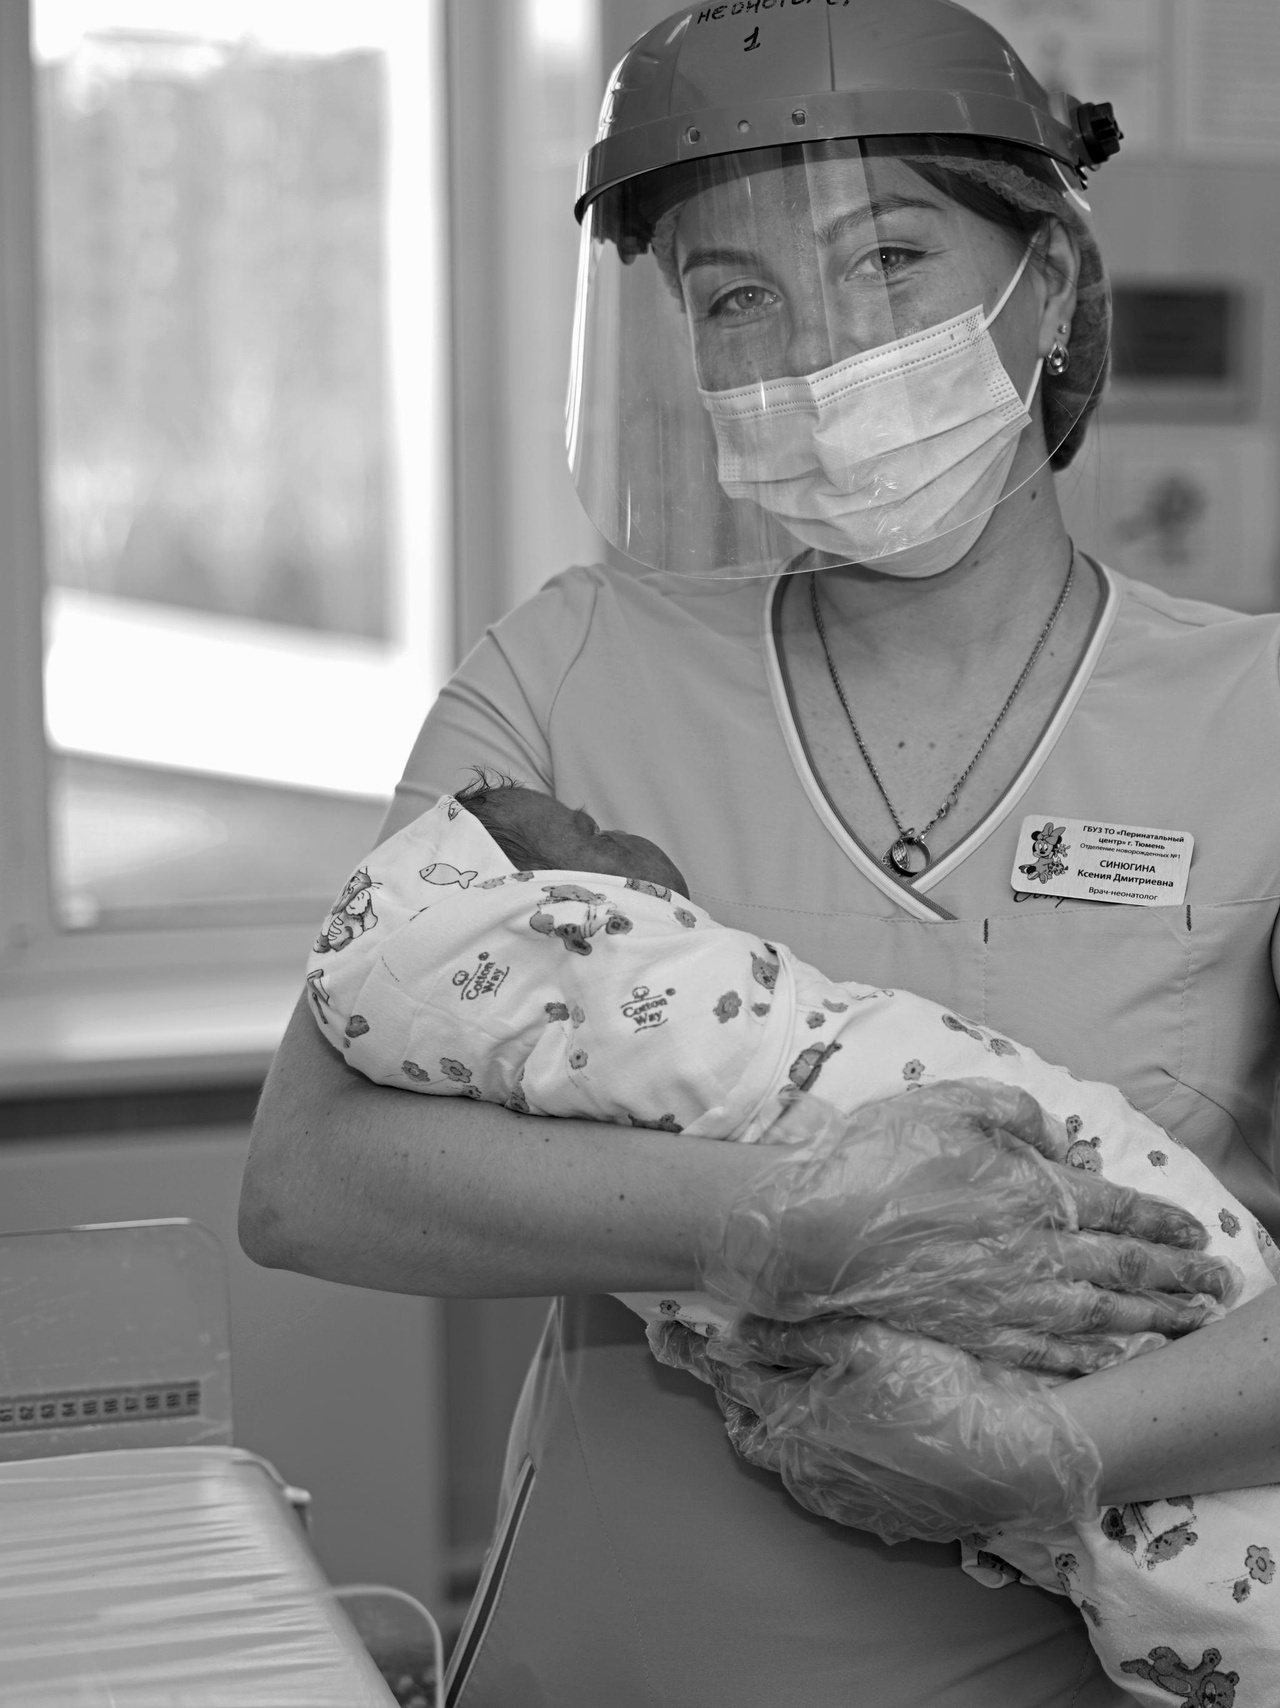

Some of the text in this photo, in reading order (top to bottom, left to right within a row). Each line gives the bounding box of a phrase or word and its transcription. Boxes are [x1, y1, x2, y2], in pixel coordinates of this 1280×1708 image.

[744, 26, 761, 51] 1
[1083, 825, 1184, 843] ГБУЗ ТО «Перинатальный
[1080, 842, 1115, 852] Отделение
[1099, 837, 1126, 846] центр»
[1135, 840, 1165, 850] Тюмень
[1099, 859, 1156, 873] СИНЮГИНА
[1077, 869, 1174, 888] Ксения Дмитриевна
[1088, 886, 1158, 901] Врач-неонатолог
[466, 961, 496, 1001] Cotton
[481, 968, 504, 994] Way
[623, 998, 668, 1018] Cotton
[634, 1010, 662, 1026] Way
